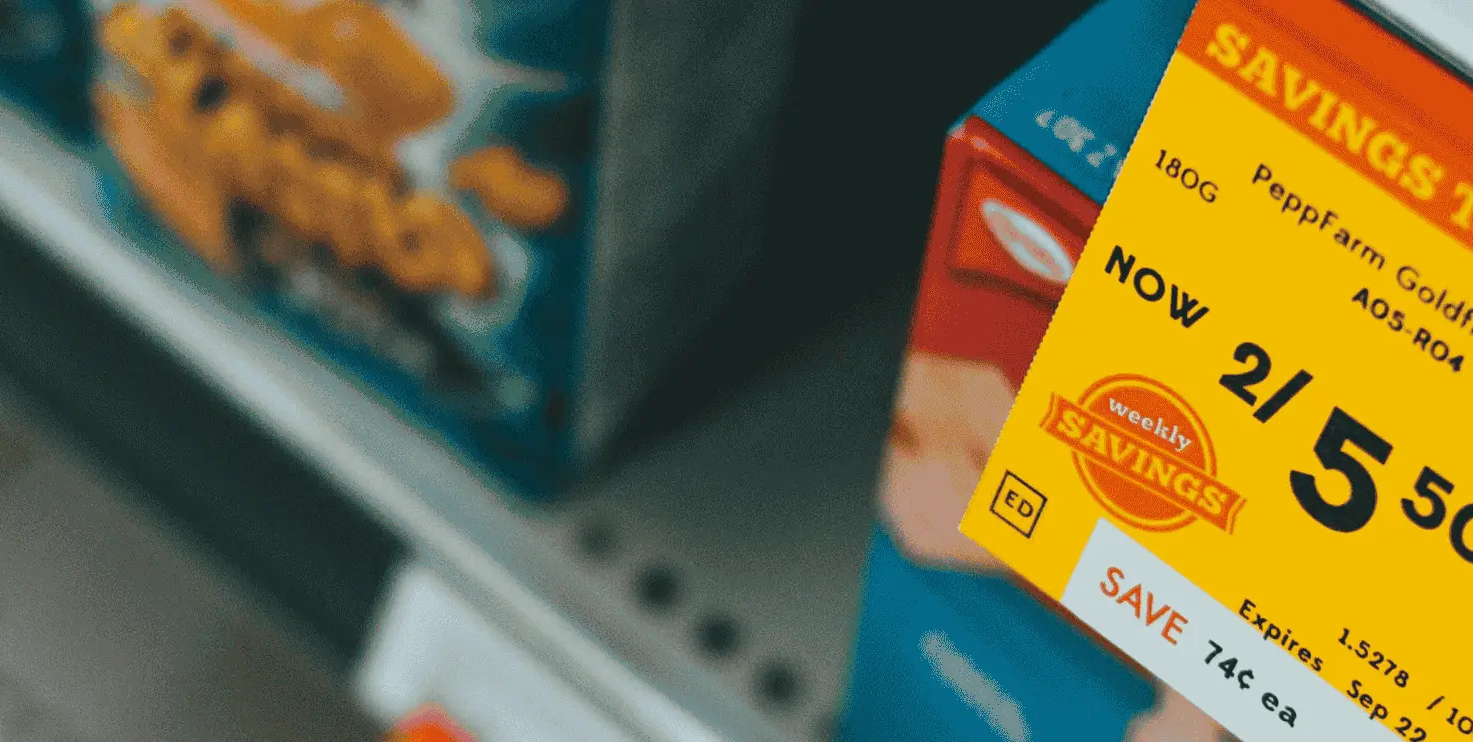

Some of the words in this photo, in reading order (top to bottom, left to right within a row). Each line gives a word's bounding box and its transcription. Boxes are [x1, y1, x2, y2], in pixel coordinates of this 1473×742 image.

[1206, 22, 1445, 201] SAVINGS
[1154, 149, 1219, 203] 180G
[1251, 163, 1386, 271] PeppFarm
[1104, 245, 1210, 329] NOW
[1056, 408, 1229, 517] SAVINGS
[1107, 396, 1193, 453] weekly
[1003, 489, 1035, 519] ED
[1099, 566, 1189, 646] SAVE
[1204, 639, 1255, 690] 74¢
[1261, 691, 1297, 729] ea
[1238, 598, 1324, 672] Expires
[1346, 679, 1389, 720] Sep
[1394, 716, 1427, 742] 22
[1337, 627, 1410, 688] 1.5278
